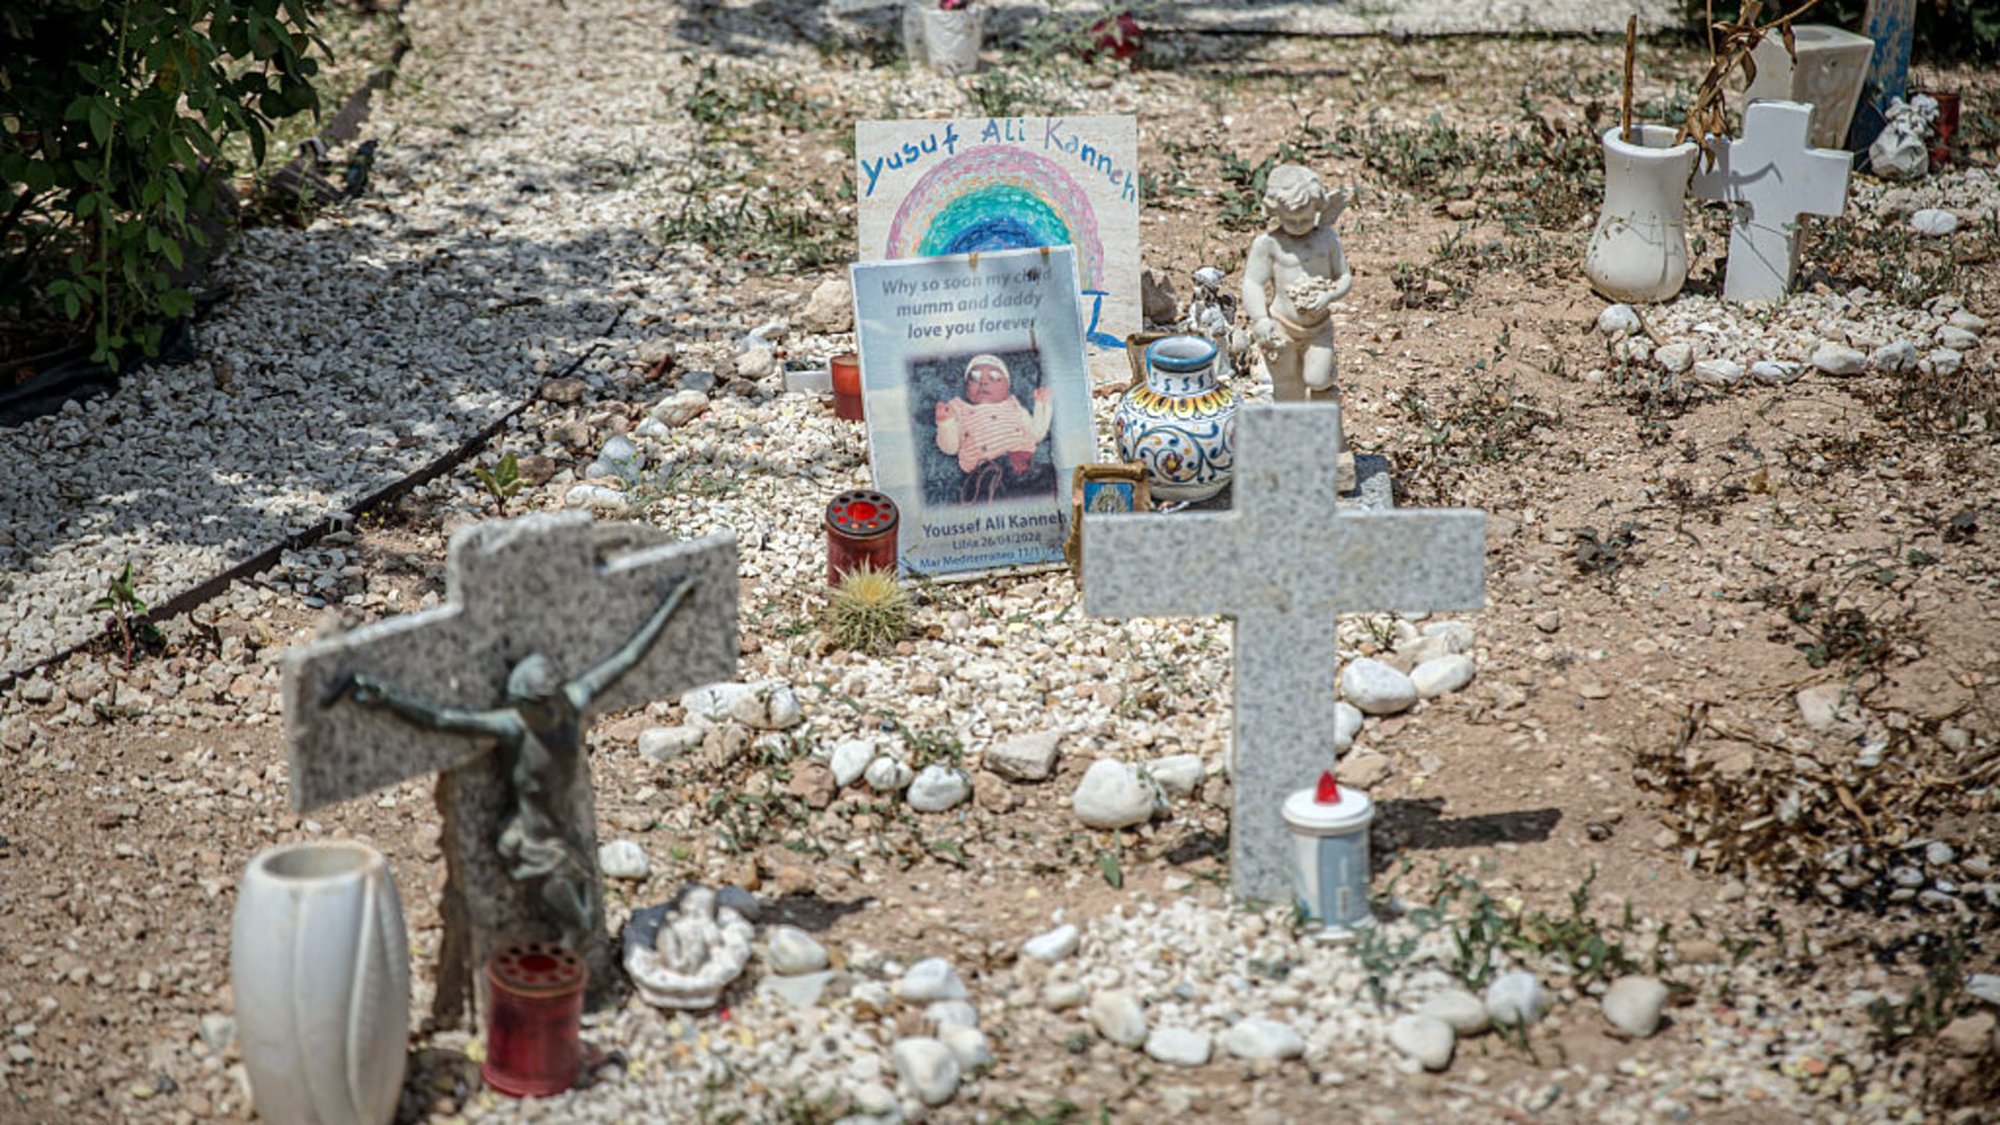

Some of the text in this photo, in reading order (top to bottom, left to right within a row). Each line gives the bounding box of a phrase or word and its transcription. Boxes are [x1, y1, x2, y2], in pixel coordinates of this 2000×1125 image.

[981, 118, 1026, 143] Ali
[1044, 119, 1136, 203] Kanneh
[881, 279, 917, 297] Why
[921, 281, 940, 292] so
[943, 277, 982, 290] soon
[986, 272, 1012, 288] my
[896, 291, 1044, 317] mumm and daddy
[907, 317, 1037, 340] love you forever
[922, 511, 1067, 537] Youssef Ali Kanneh
[919, 557, 941, 569] Mar
